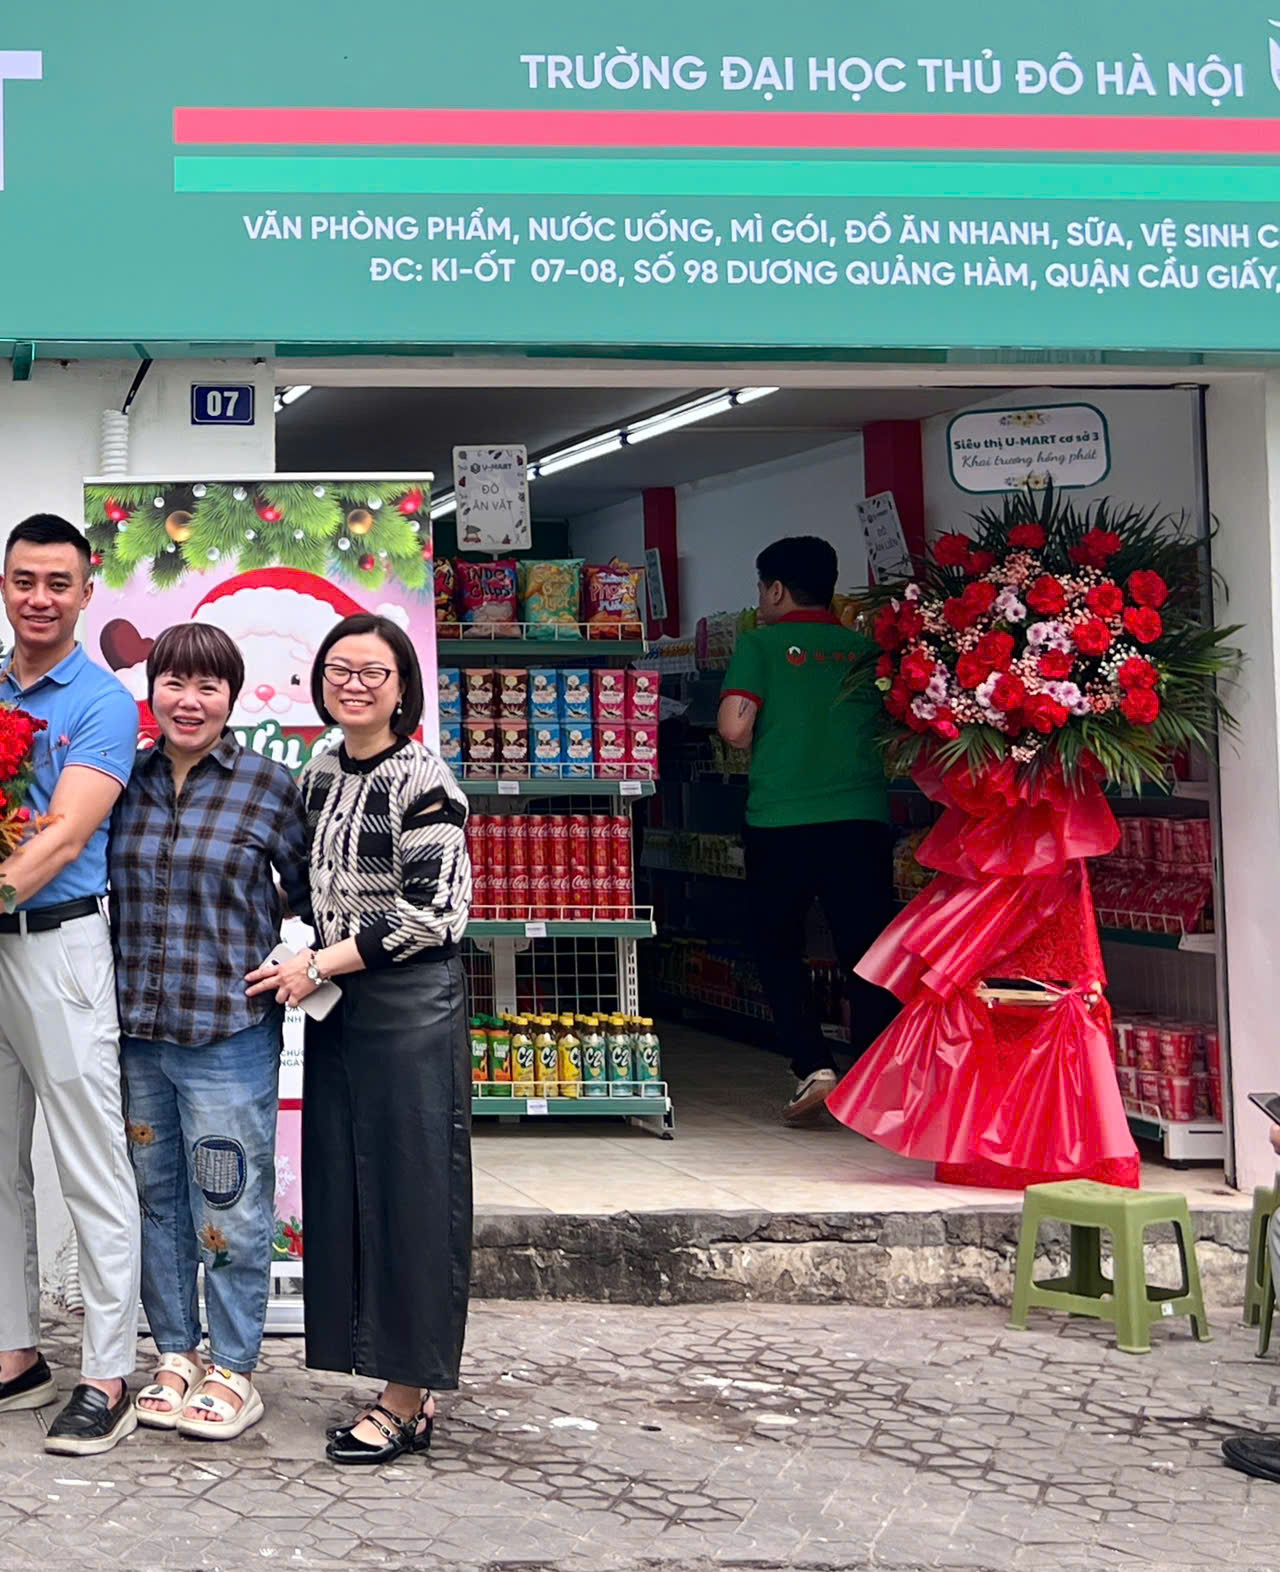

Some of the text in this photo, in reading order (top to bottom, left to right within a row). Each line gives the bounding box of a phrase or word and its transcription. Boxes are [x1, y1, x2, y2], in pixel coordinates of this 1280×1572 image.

[520, 46, 1244, 108] TRƯỜNG ĐẠI HỌC THỦ ĐÔ HÀ NỘI
[242, 209, 302, 240] VĂN
[311, 210, 419, 241] PHÒNG
[427, 207, 520, 246] PHẨM,
[528, 210, 616, 243] NƯỚC
[625, 209, 722, 247] UỐNG,
[730, 213, 763, 243] MÌ
[771, 213, 836, 248] GÓI,
[845, 211, 890, 244] ĐỒ
[899, 214, 940, 245] ĂN
[948, 220, 1059, 250] NHANH,
[1066, 216, 1133, 251] SỮA,
[1140, 217, 1177, 254] VỆ
[1184, 223, 1250, 249] SINH
[369, 249, 1280, 295] ĐC: KI-ỐT 07-08, SỐ 98 DƯƠNG QUẢNG HÀM, QUẬN CẦU GIẤY,
[206, 390, 239, 417] 07
[953, 431, 1100, 451] Siêu thị U-MART cơ sở 3
[962, 453, 992, 469] Khai
[1068, 447, 1097, 465] phát
[516, 1046, 535, 1067] C2
[540, 1046, 558, 1067] C2
[585, 1046, 601, 1067] C2
[612, 1046, 630, 1067] C2
[643, 1046, 659, 1067] C2
